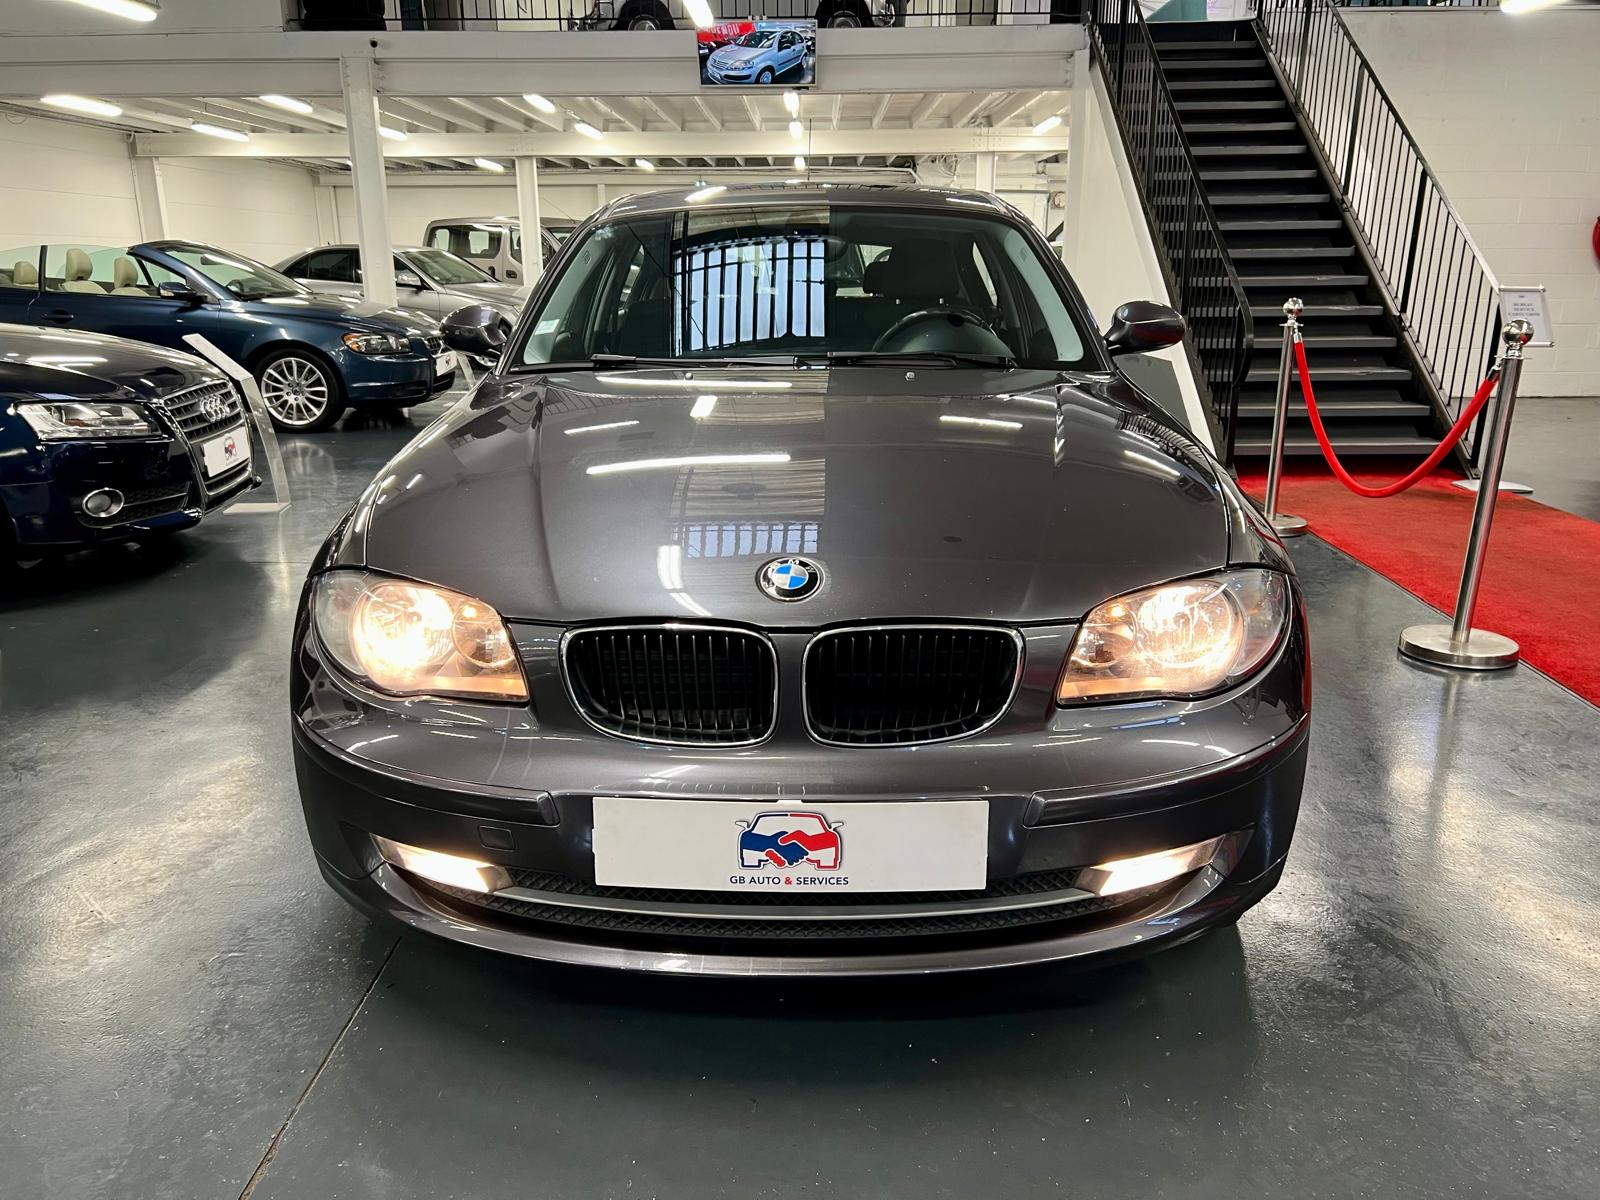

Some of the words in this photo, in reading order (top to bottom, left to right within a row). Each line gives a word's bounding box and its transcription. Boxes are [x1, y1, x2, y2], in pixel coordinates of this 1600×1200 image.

[729, 875, 746, 885] GB
[748, 876, 781, 885] AUTO
[784, 876, 793, 885] &
[796, 876, 849, 886] SERVICES
